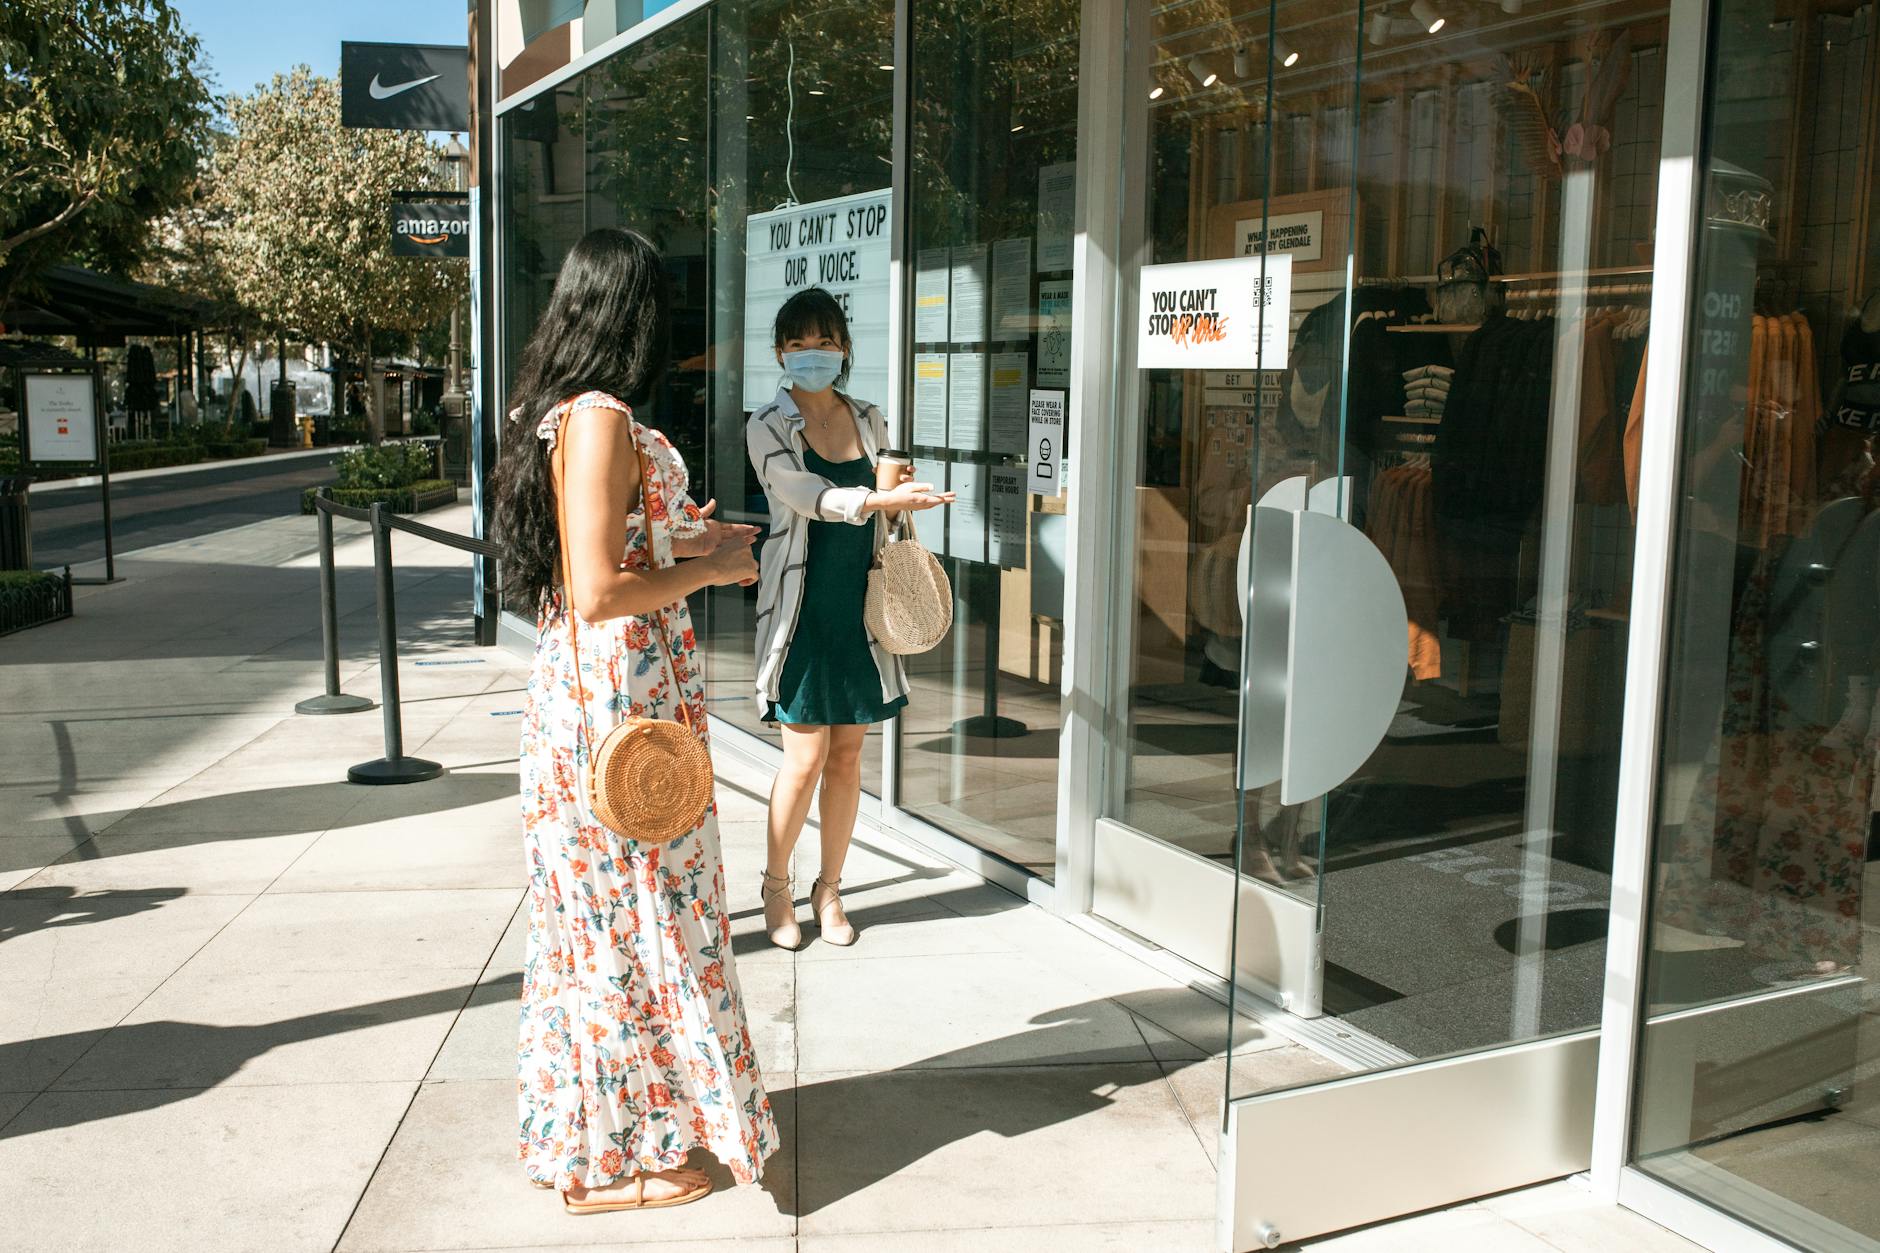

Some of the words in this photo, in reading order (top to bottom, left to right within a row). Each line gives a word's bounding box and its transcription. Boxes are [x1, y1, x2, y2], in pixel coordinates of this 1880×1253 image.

[769, 221, 792, 251] YOU
[798, 212, 837, 247] CAN'T
[846, 203, 887, 240] STOP
[1270, 224, 1308, 239] HAPPENING
[1244, 243, 1252, 255] AT
[1267, 240, 1277, 251] BY
[1278, 235, 1312, 250] GLENDALE
[785, 257, 808, 287] OUR
[819, 250, 859, 284] VOICE.
[1152, 291, 1177, 313] YOU
[1179, 288, 1217, 312] CAN'T
[1225, 374, 1240, 386] GET
[1032, 400, 1045, 408] PLEASE
[1046, 401, 1057, 409] WEAR
[1058, 402, 1062, 410] A
[1032, 408, 1041, 416] FACE
[1041, 409, 1061, 417] COVERING
[1031, 416, 1043, 424] WHILE
[1044, 417, 1049, 425] IN
[1049, 417, 1062, 426] STORE
[992, 475, 1017, 485] TEMPORARY
[991, 484, 1004, 494] STORE
[1005, 486, 1019, 495] HOURS
